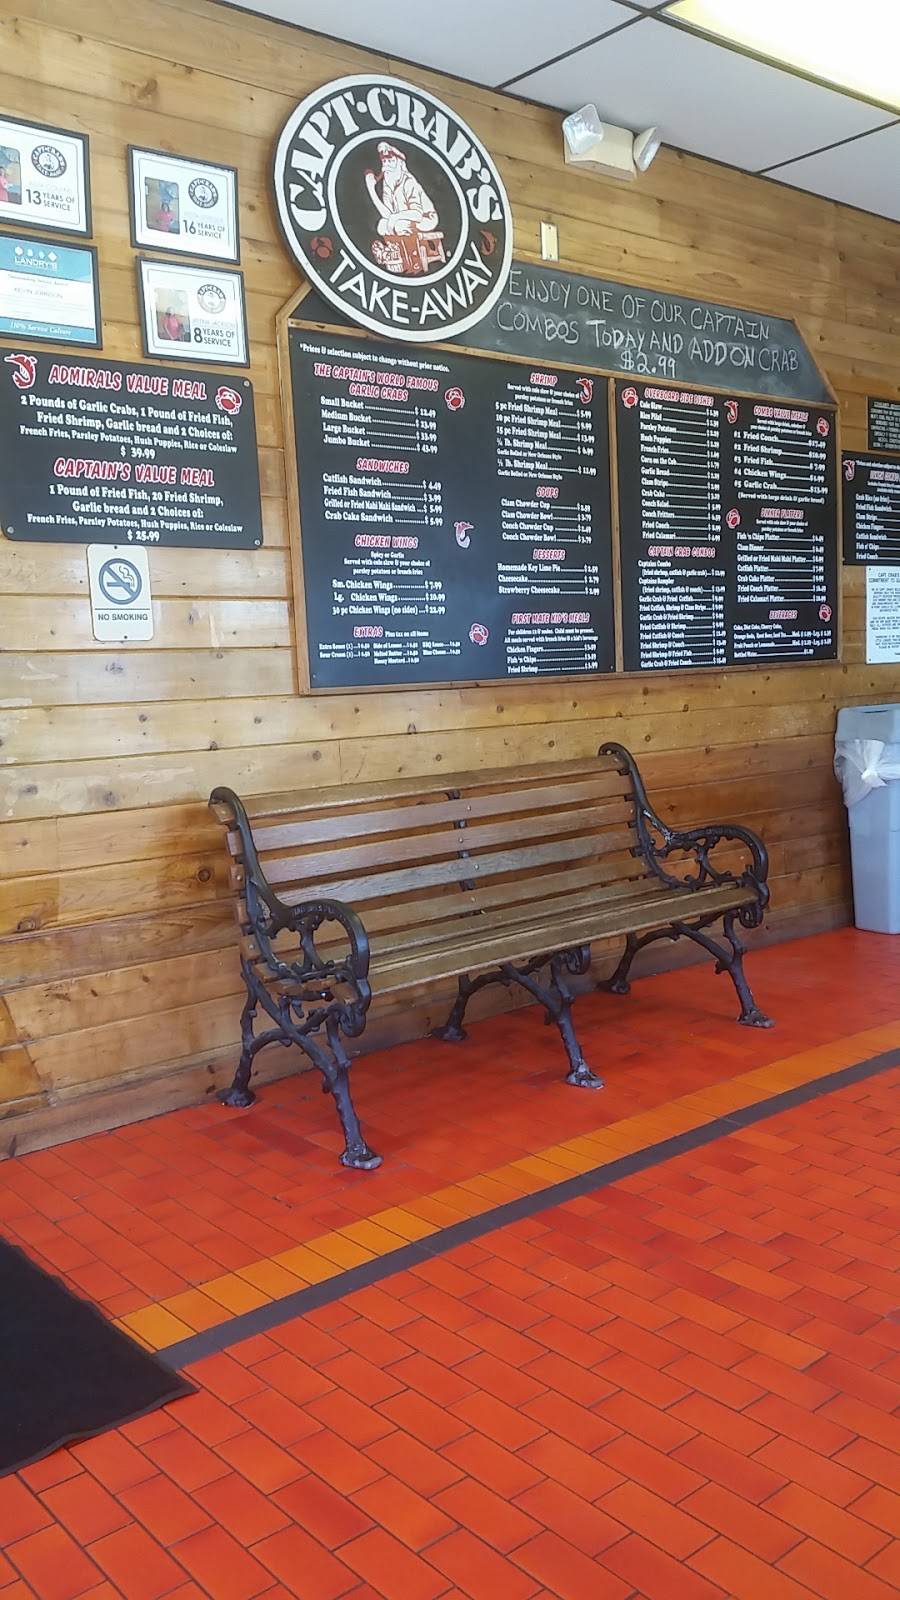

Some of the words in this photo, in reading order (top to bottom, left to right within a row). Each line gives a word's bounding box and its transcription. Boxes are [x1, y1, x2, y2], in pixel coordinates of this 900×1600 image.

[26, 189, 41, 205] 13
[43, 192, 63, 203] YEARS
[65, 195, 75, 203] OF
[44, 199, 70, 212] SERVICE
[183, 220, 196, 234] 16
[198, 222, 216, 232] YEARS
[198, 230, 222, 239] SERVICE
[329, 241, 493, 325] TAKE-AWAY
[509, 269, 571, 309] ENJOY
[577, 285, 614, 313] ONE
[622, 295, 646, 318] OF
[651, 300, 687, 325] OUR
[690, 307, 769, 340] CAPTAIN
[194, 328, 203, 344] 8
[203, 328, 222, 338] YEARS
[204, 336, 232, 347] SERVICE
[497, 302, 580, 344] COMBOS
[586, 319, 646, 352] TODAY
[650, 331, 684, 354] AND
[758, 349, 799, 372] CRAB
[327, 348, 352, 358] selection
[352, 351, 371, 361] subject
[379, 355, 397, 366] change
[398, 359, 418, 368] without
[419, 362, 432, 370] prior
[620, 350, 676, 378] $2.99
[48, 364, 122, 391] ADMIRALS
[127, 374, 168, 396] VALUE
[172, 379, 207, 400] MEAL
[314, 363, 331, 377] THE
[332, 366, 375, 383] CAPTAIN'S
[376, 372, 405, 387] WORLD
[406, 376, 439, 391] FAMOUS
[530, 372, 558, 386] SHRIMP
[349, 383, 380, 398] GARLIC
[381, 387, 408, 401] CRABS
[320, 396, 340, 408] Small
[341, 397, 364, 410] Bucket
[20, 395, 27, 405] 2
[29, 394, 65, 408] Pounds
[67, 399, 77, 409] of
[79, 400, 108, 412] Garlic
[110, 403, 139, 418] Crabs,
[148, 407, 176, 420] Pound
[177, 412, 186, 420] of
[188, 411, 211, 424] Fried
[213, 414, 233, 428] Fish,
[321, 409, 348, 421] Medium
[349, 411, 372, 423] Bucket
[37, 411, 64, 424] Fried
[66, 414, 104, 430] Shrimp,
[106, 418, 134, 431] Garlic
[136, 421, 161, 434] bread
[163, 426, 180, 435] and
[181, 427, 187, 435] 2
[188, 427, 220, 439] Choices
[323, 422, 342, 434] Large
[343, 424, 366, 435] Bucket
[20, 425, 48, 437] French
[49, 428, 70, 439] Fries,
[72, 430, 98, 442] Parsley
[100, 432, 133, 444] Potatoes,
[134, 436, 153, 446] Hush
[154, 437, 183, 450] Puppies,
[184, 440, 199, 450] Rice
[208, 443, 238, 453] Coleslaw
[323, 434, 347, 445] Jumbo
[348, 436, 370, 447] Bucket
[743, 431, 759, 440] Fried
[120, 446, 126, 457] $
[131, 447, 155, 459] 39.99
[743, 443, 759, 453] Fried
[356, 457, 410, 474] SANDWICHES
[743, 456, 760, 464] Fried
[54, 457, 131, 481] CAPTAIN'S
[134, 464, 177, 484] VALUE
[180, 467, 214, 486] MEAL
[744, 468, 768, 477] Chicken
[769, 470, 786, 480] Wings
[323, 473, 348, 484] Catfish
[349, 475, 382, 486] Sandwich
[49, 484, 55, 494] 1
[57, 484, 89, 497] Pound
[90, 486, 100, 497] of
[102, 487, 127, 498] Fried
[128, 489, 151, 502] Fish,
[152, 492, 163, 501] 20
[164, 491, 187, 503] Fried
[189, 492, 224, 507] Shrimp,
[324, 485, 342, 496] Fried
[343, 487, 358, 497] Fish
[359, 488, 392, 499] Sandwich
[536, 486, 559, 498] SOUPS
[72, 501, 102, 513] Garlic
[103, 502, 130, 515] bread
[132, 505, 149, 515] and
[150, 508, 156, 516] 2
[157, 506, 191, 518] Choices
[325, 510, 342, 520] Crab
[343, 512, 360, 521] Cake
[361, 512, 393, 522] Sandwich
[27, 513, 55, 524] French
[56, 515, 78, 526] Fries,
[79, 516, 106, 527] Parsley
[107, 518, 140, 529] Potatoes,
[141, 519, 159, 528] Hush
[160, 520, 189, 531] Puppies,
[190, 522, 204, 531] Rice
[214, 522, 243, 532] Coleslaw
[127, 530, 132, 541] $
[136, 531, 159, 541] 25.99
[355, 534, 391, 547] CHICKEN
[392, 536, 418, 548] WINGS
[533, 549, 566, 560] DESSERTS
[332, 580, 345, 588] Sm.
[346, 580, 372, 589] Chicken
[373, 580, 393, 591] Wings
[350, 593, 378, 602] Chicken
[378, 593, 398, 603] Wings
[353, 626, 383, 638] EXTRAS
